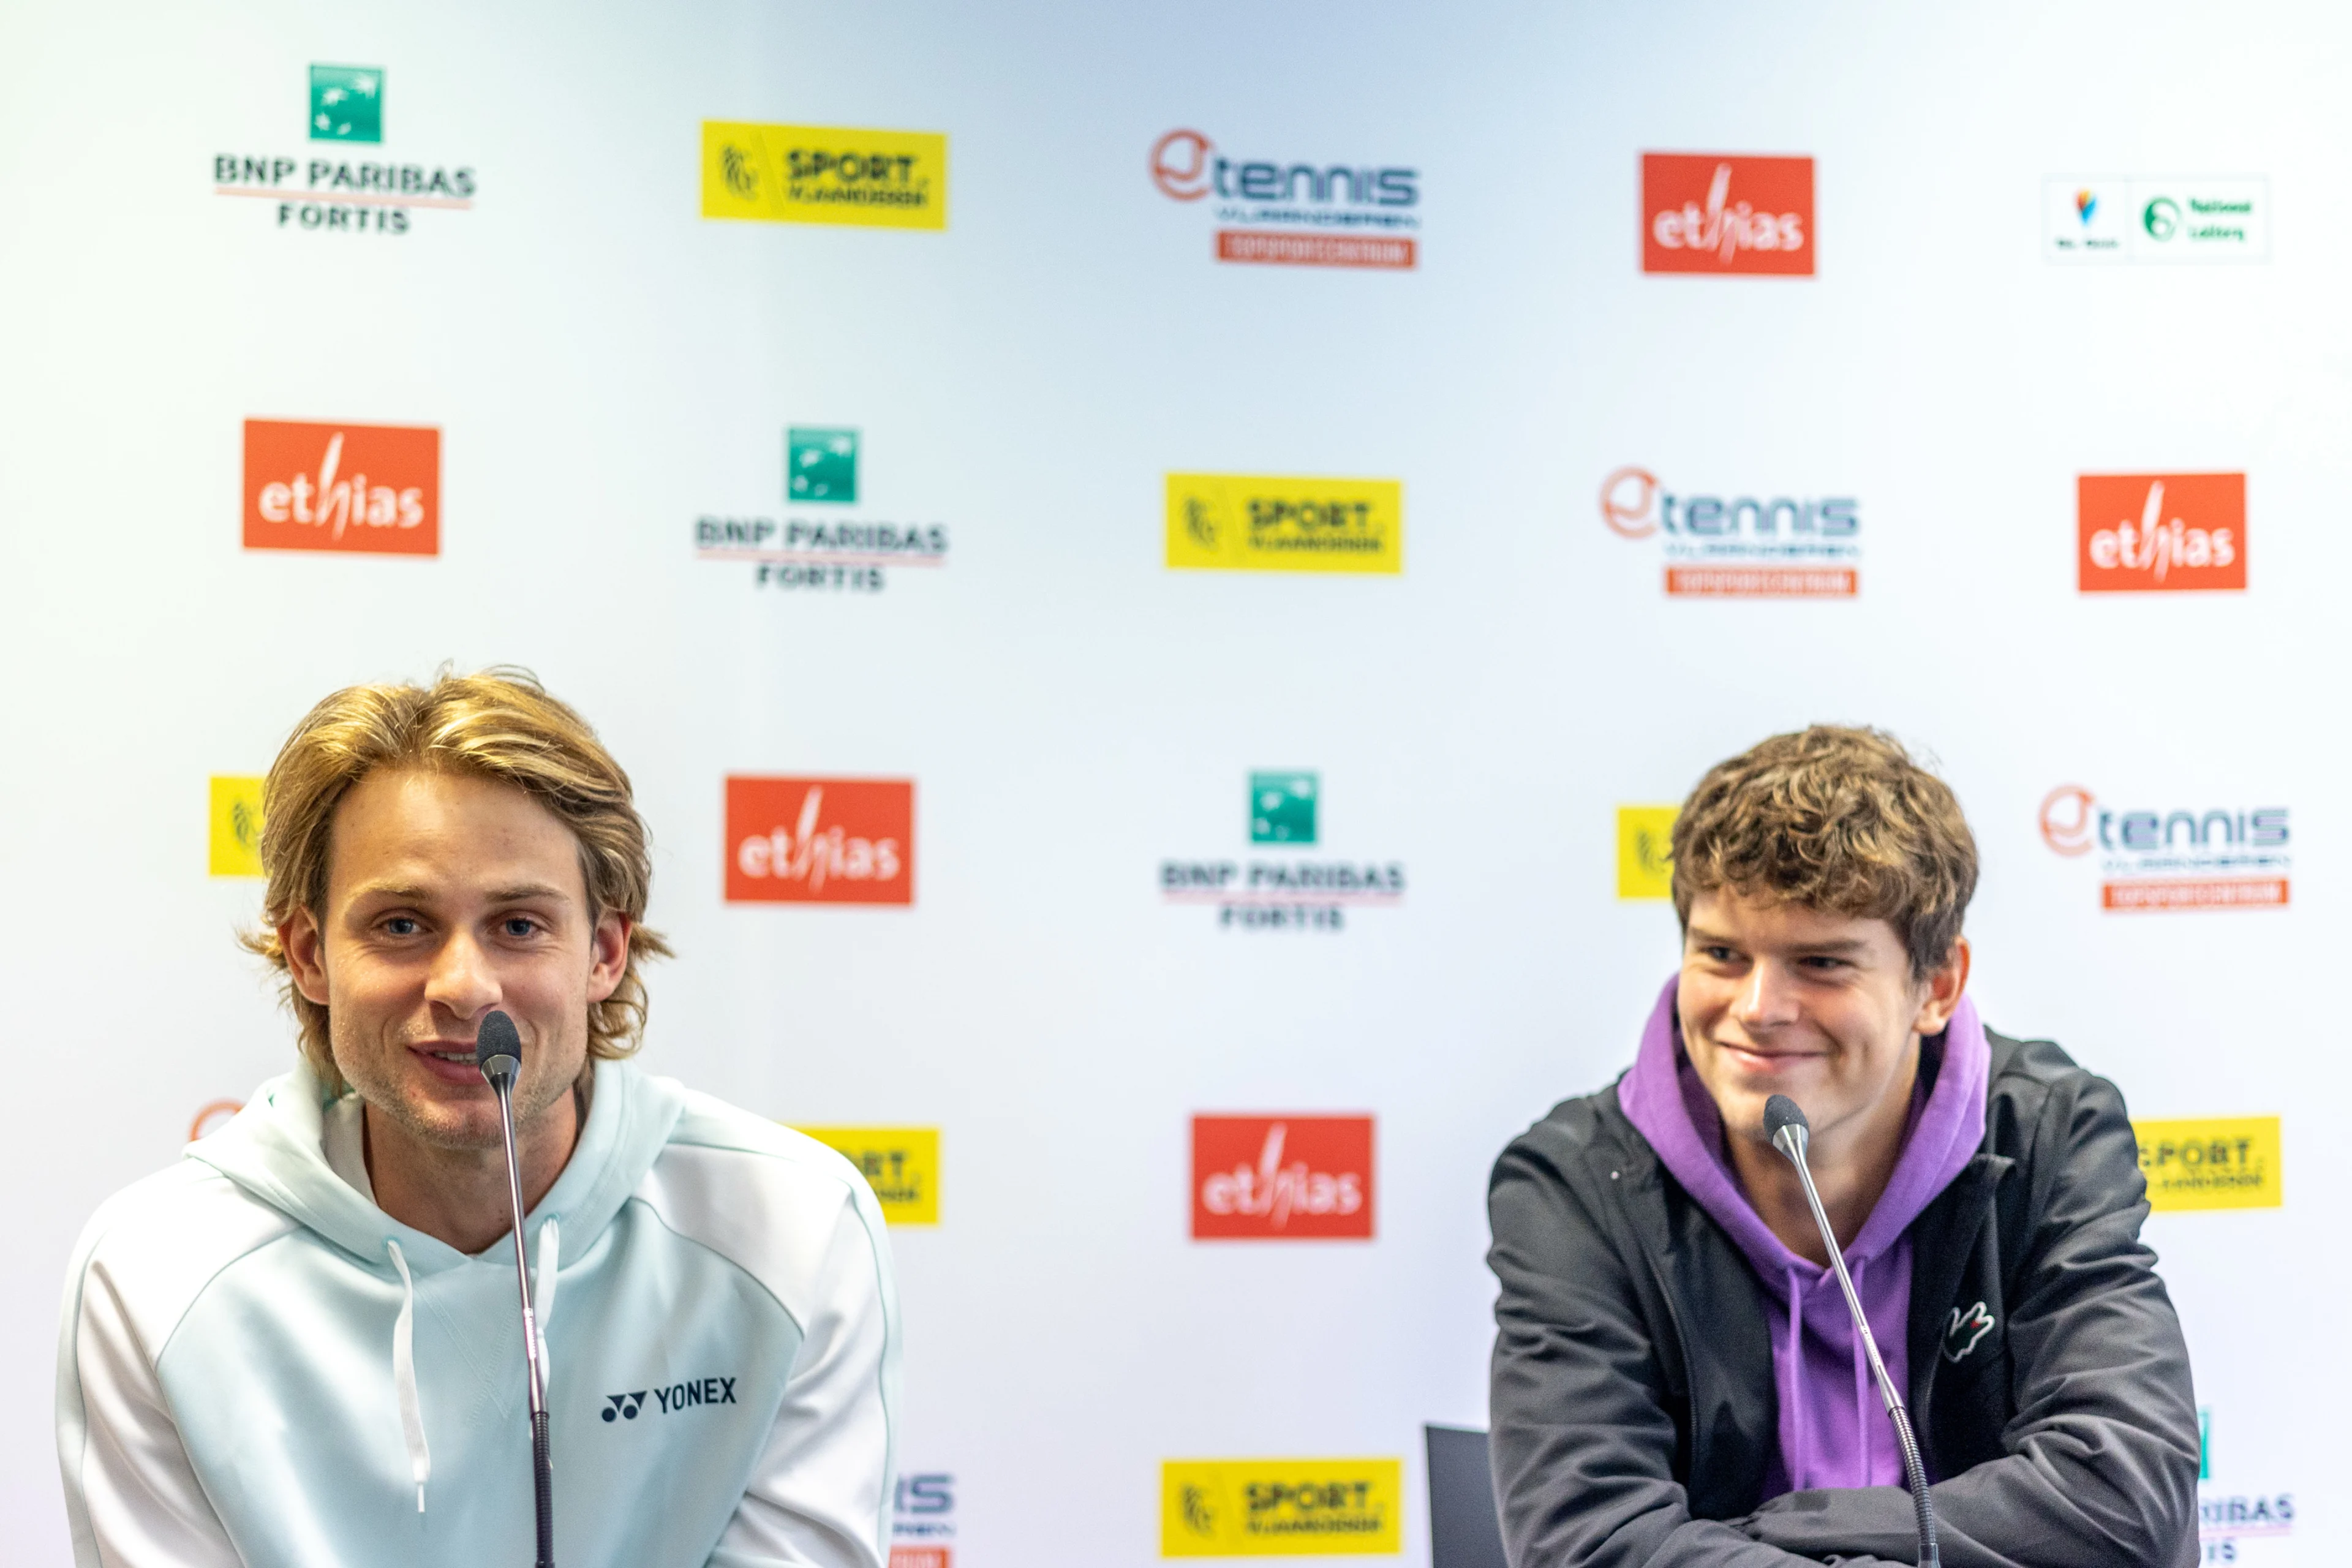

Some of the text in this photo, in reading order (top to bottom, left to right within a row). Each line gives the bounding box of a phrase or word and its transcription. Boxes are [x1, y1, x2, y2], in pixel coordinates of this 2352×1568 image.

[214, 153, 477, 198] BNP PARIBAS
[277, 202, 412, 235] FORTIS
[1652, 162, 1804, 265] ethias
[258, 431, 424, 543] ethias
[696, 516, 951, 554] BNP PARIBAS
[2089, 479, 2236, 584] ethias
[755, 562, 886, 592] FORTIS
[737, 783, 902, 895] ethias
[1201, 1120, 1363, 1231] ethias
[654, 1377, 737, 1414] YONEX
